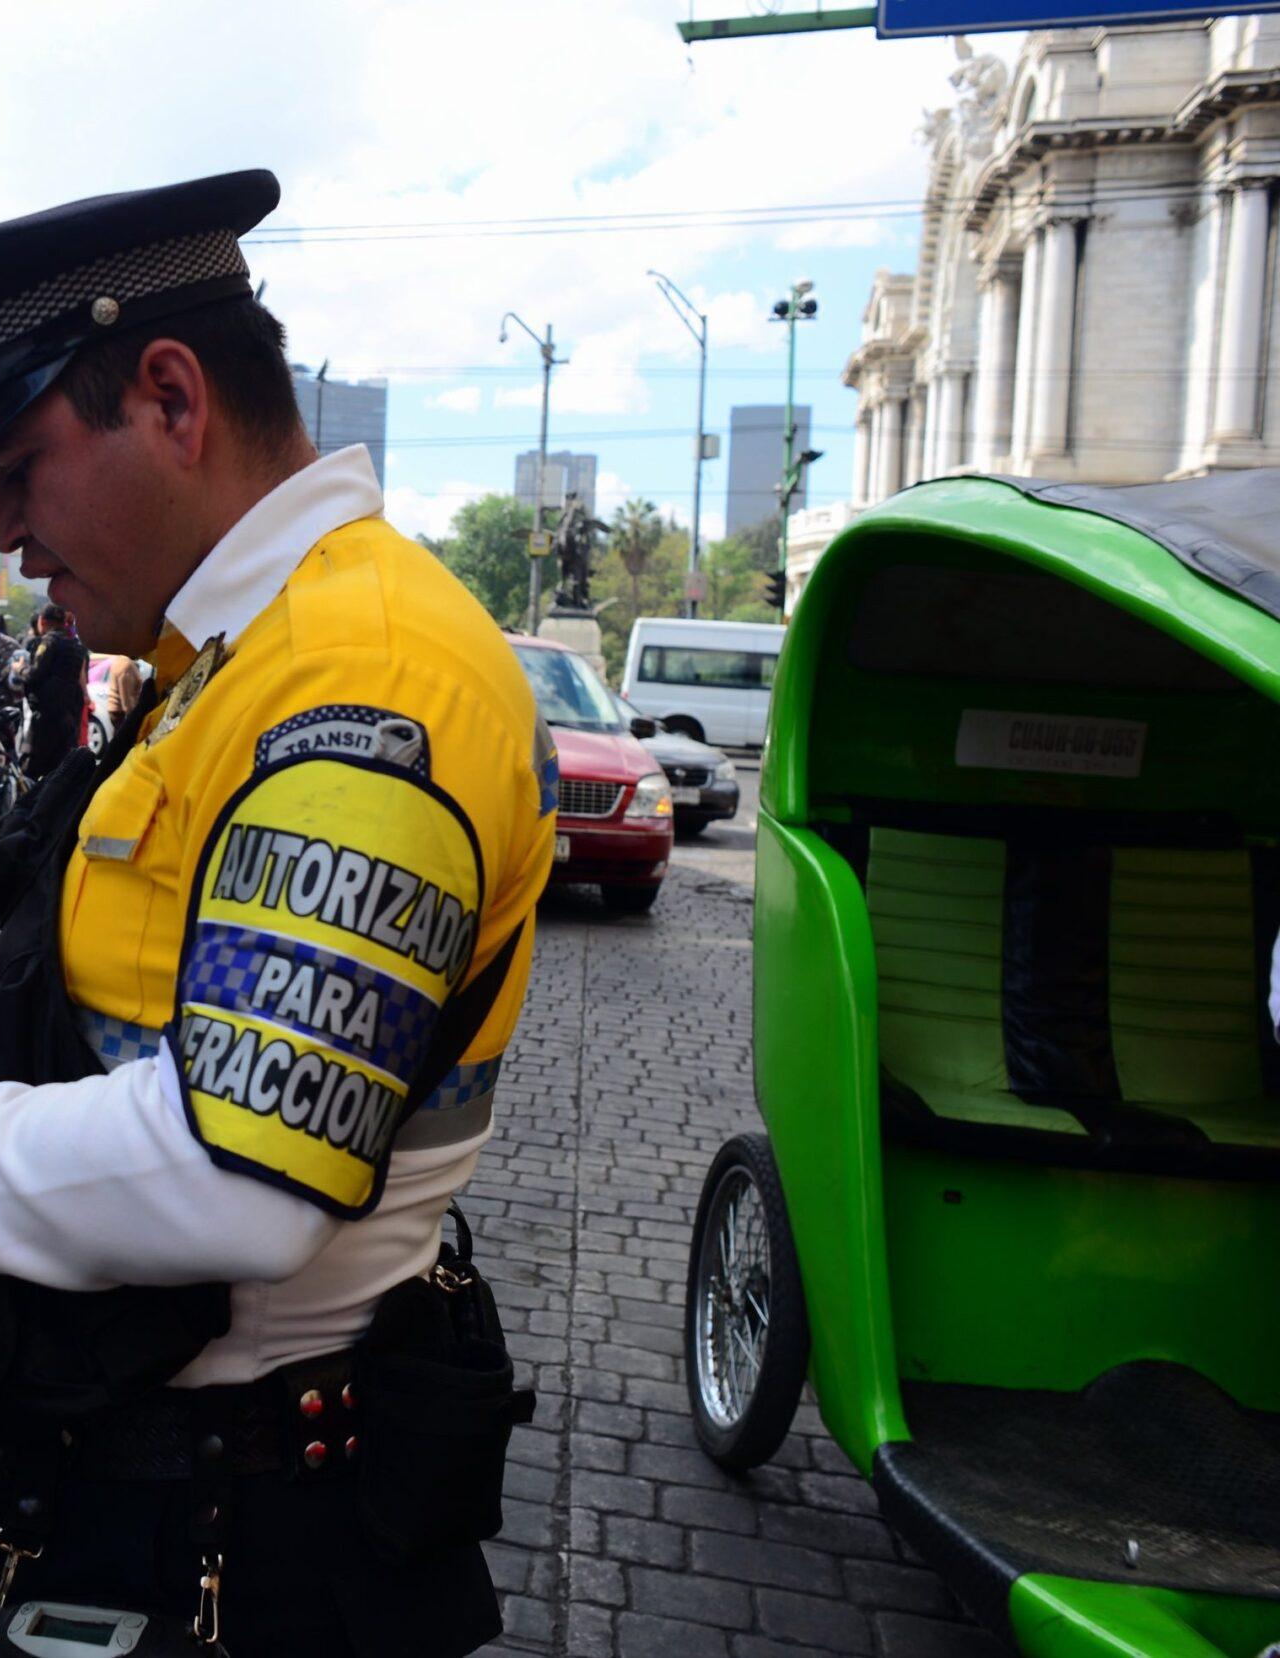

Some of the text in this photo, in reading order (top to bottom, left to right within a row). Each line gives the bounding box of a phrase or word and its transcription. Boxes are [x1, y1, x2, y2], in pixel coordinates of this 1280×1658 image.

[284, 730, 373, 755] TRANSIT
[212, 824, 478, 986] AUTORIZADO
[249, 952, 381, 1050] PARA
[180, 1014, 404, 1166] FRACCIONA
